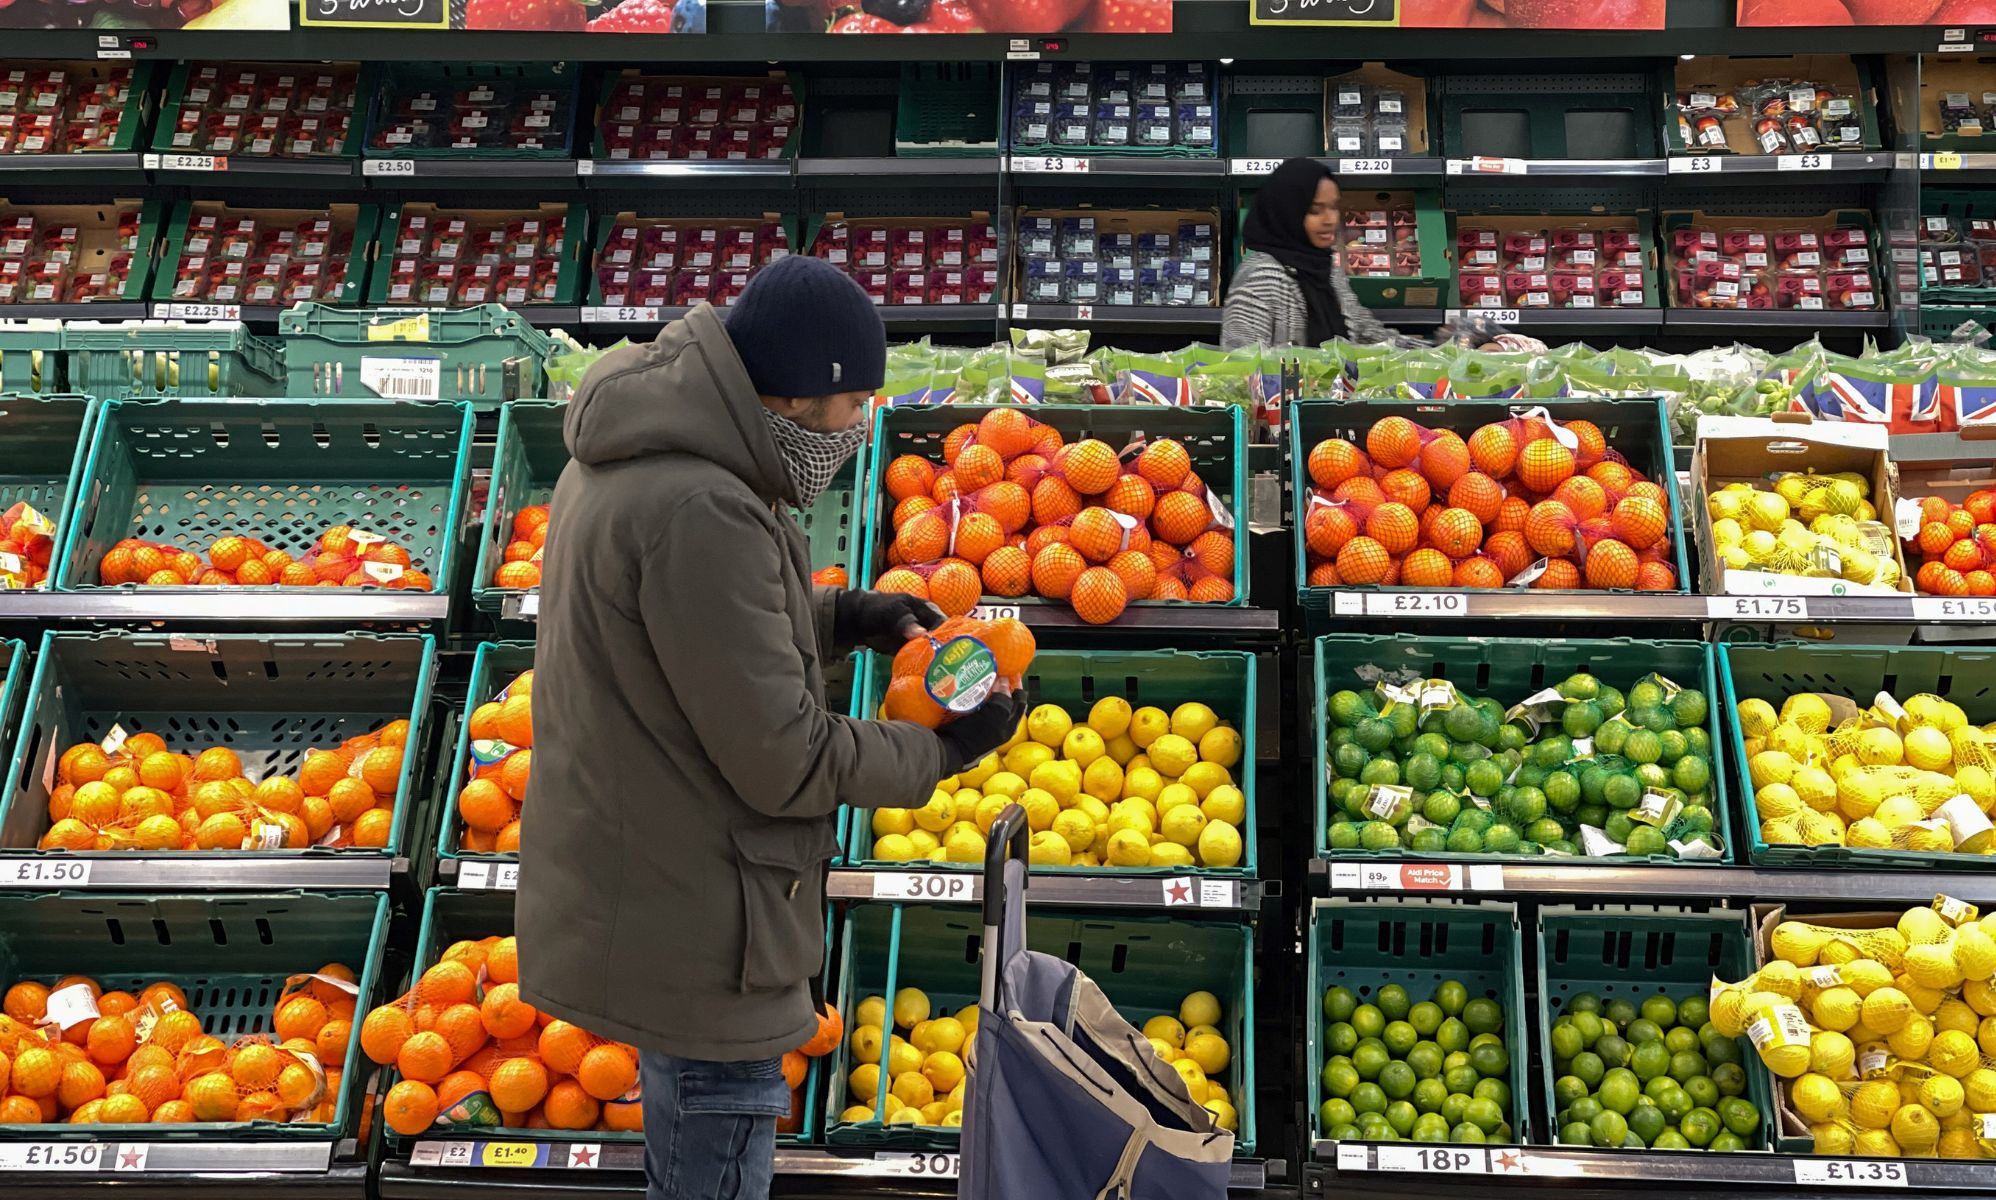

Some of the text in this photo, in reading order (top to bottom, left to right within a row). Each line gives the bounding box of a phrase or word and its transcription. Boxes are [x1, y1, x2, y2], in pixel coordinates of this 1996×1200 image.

[178, 156, 212, 168] £2.25
[378, 161, 412, 172] £2.50
[1045, 157, 1064, 171] £3
[1355, 161, 1390, 171] £2.20
[1690, 157, 1711, 171] £3
[1800, 155, 1821, 169] £3
[184, 306, 219, 317] £2.25
[618, 308, 637, 321] £2
[1482, 311, 1517, 322] £2.50
[1394, 595, 1459, 611] £2.10
[1735, 598, 1801, 615] £1.75
[1941, 600, 1996, 615] £1.5
[967, 607, 1015, 621] 2.10
[16, 862, 85, 880] £1.50
[1368, 872, 1388, 883] 89p
[1407, 869, 1444, 877] Aldi Price
[906, 875, 964, 898] 30p
[25, 1145, 97, 1166] £1.50
[449, 1146, 467, 1157] £2
[494, 1147, 528, 1158] £1.40
[1416, 1149, 1471, 1171] 18p
[1826, 1162, 1901, 1181] £1.35
